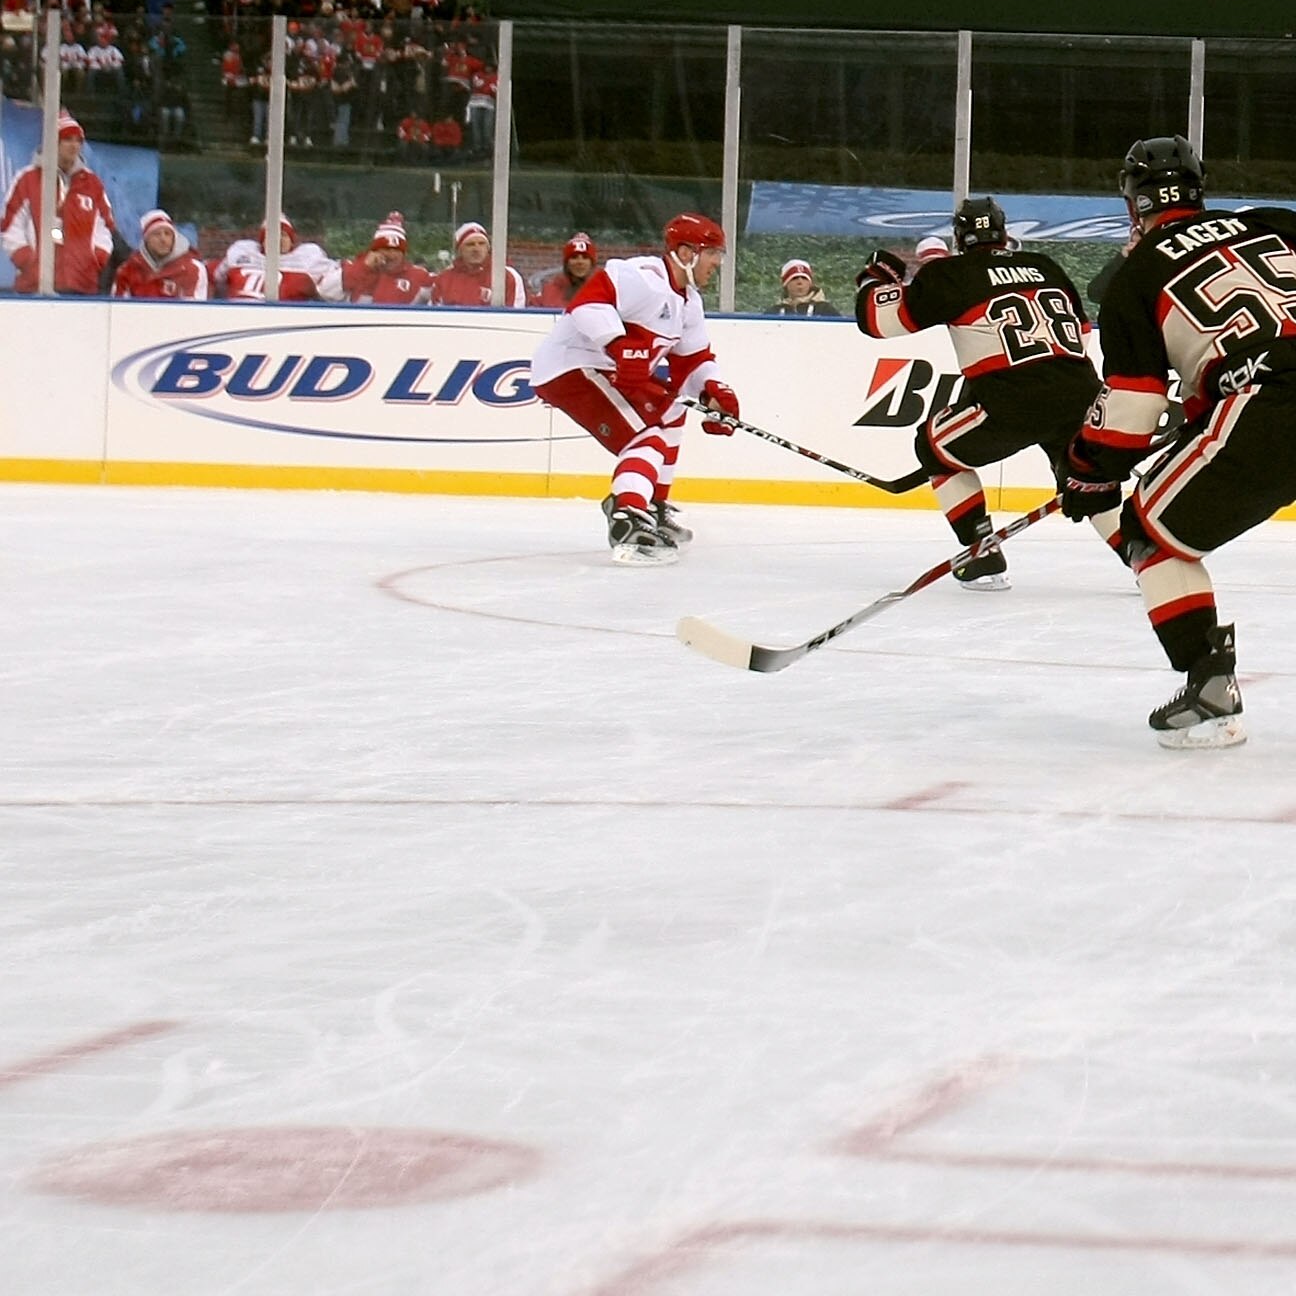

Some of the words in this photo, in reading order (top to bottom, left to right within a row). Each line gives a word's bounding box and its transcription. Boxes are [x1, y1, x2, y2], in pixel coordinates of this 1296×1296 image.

[1159, 185, 1180, 204] 55
[974, 215, 990, 230] 28
[1156, 218, 1248, 260] EAGER
[987, 266, 1046, 286] ADAMS
[986, 288, 1087, 366] 28
[150, 352, 375, 402] BUD
[382, 358, 551, 407] LIG
